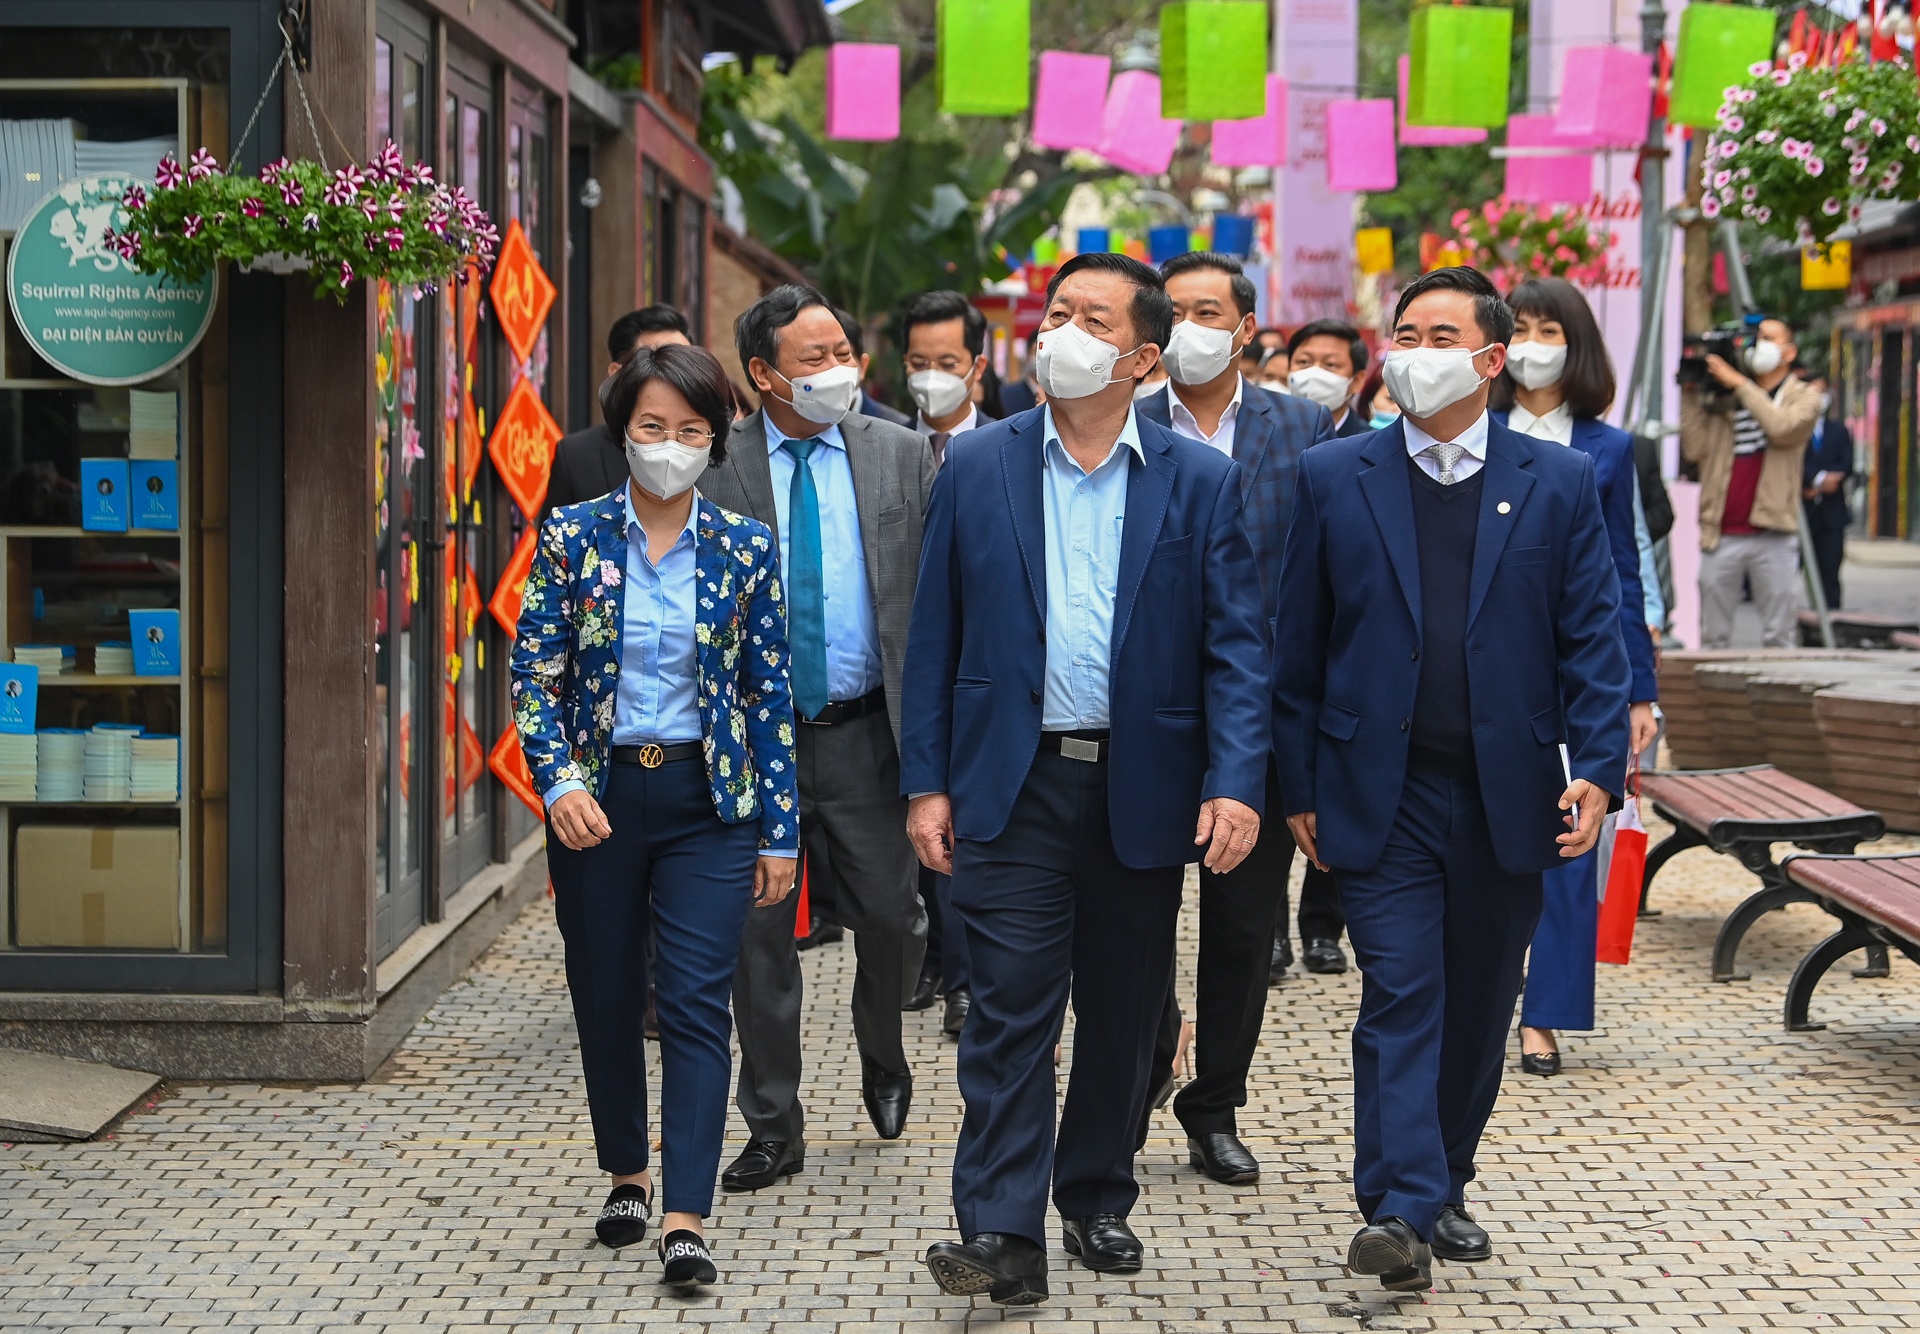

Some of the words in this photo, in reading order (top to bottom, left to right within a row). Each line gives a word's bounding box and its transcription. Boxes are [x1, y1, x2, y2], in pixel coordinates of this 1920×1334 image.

[21, 282, 85, 301] Squirrel
[89, 284, 141, 303] Rights
[145, 285, 204, 304] Agency
[54, 306, 176, 321] www.squi-agency.com
[70, 325, 102, 345] DIỆN
[105, 324, 133, 342] BẢN
